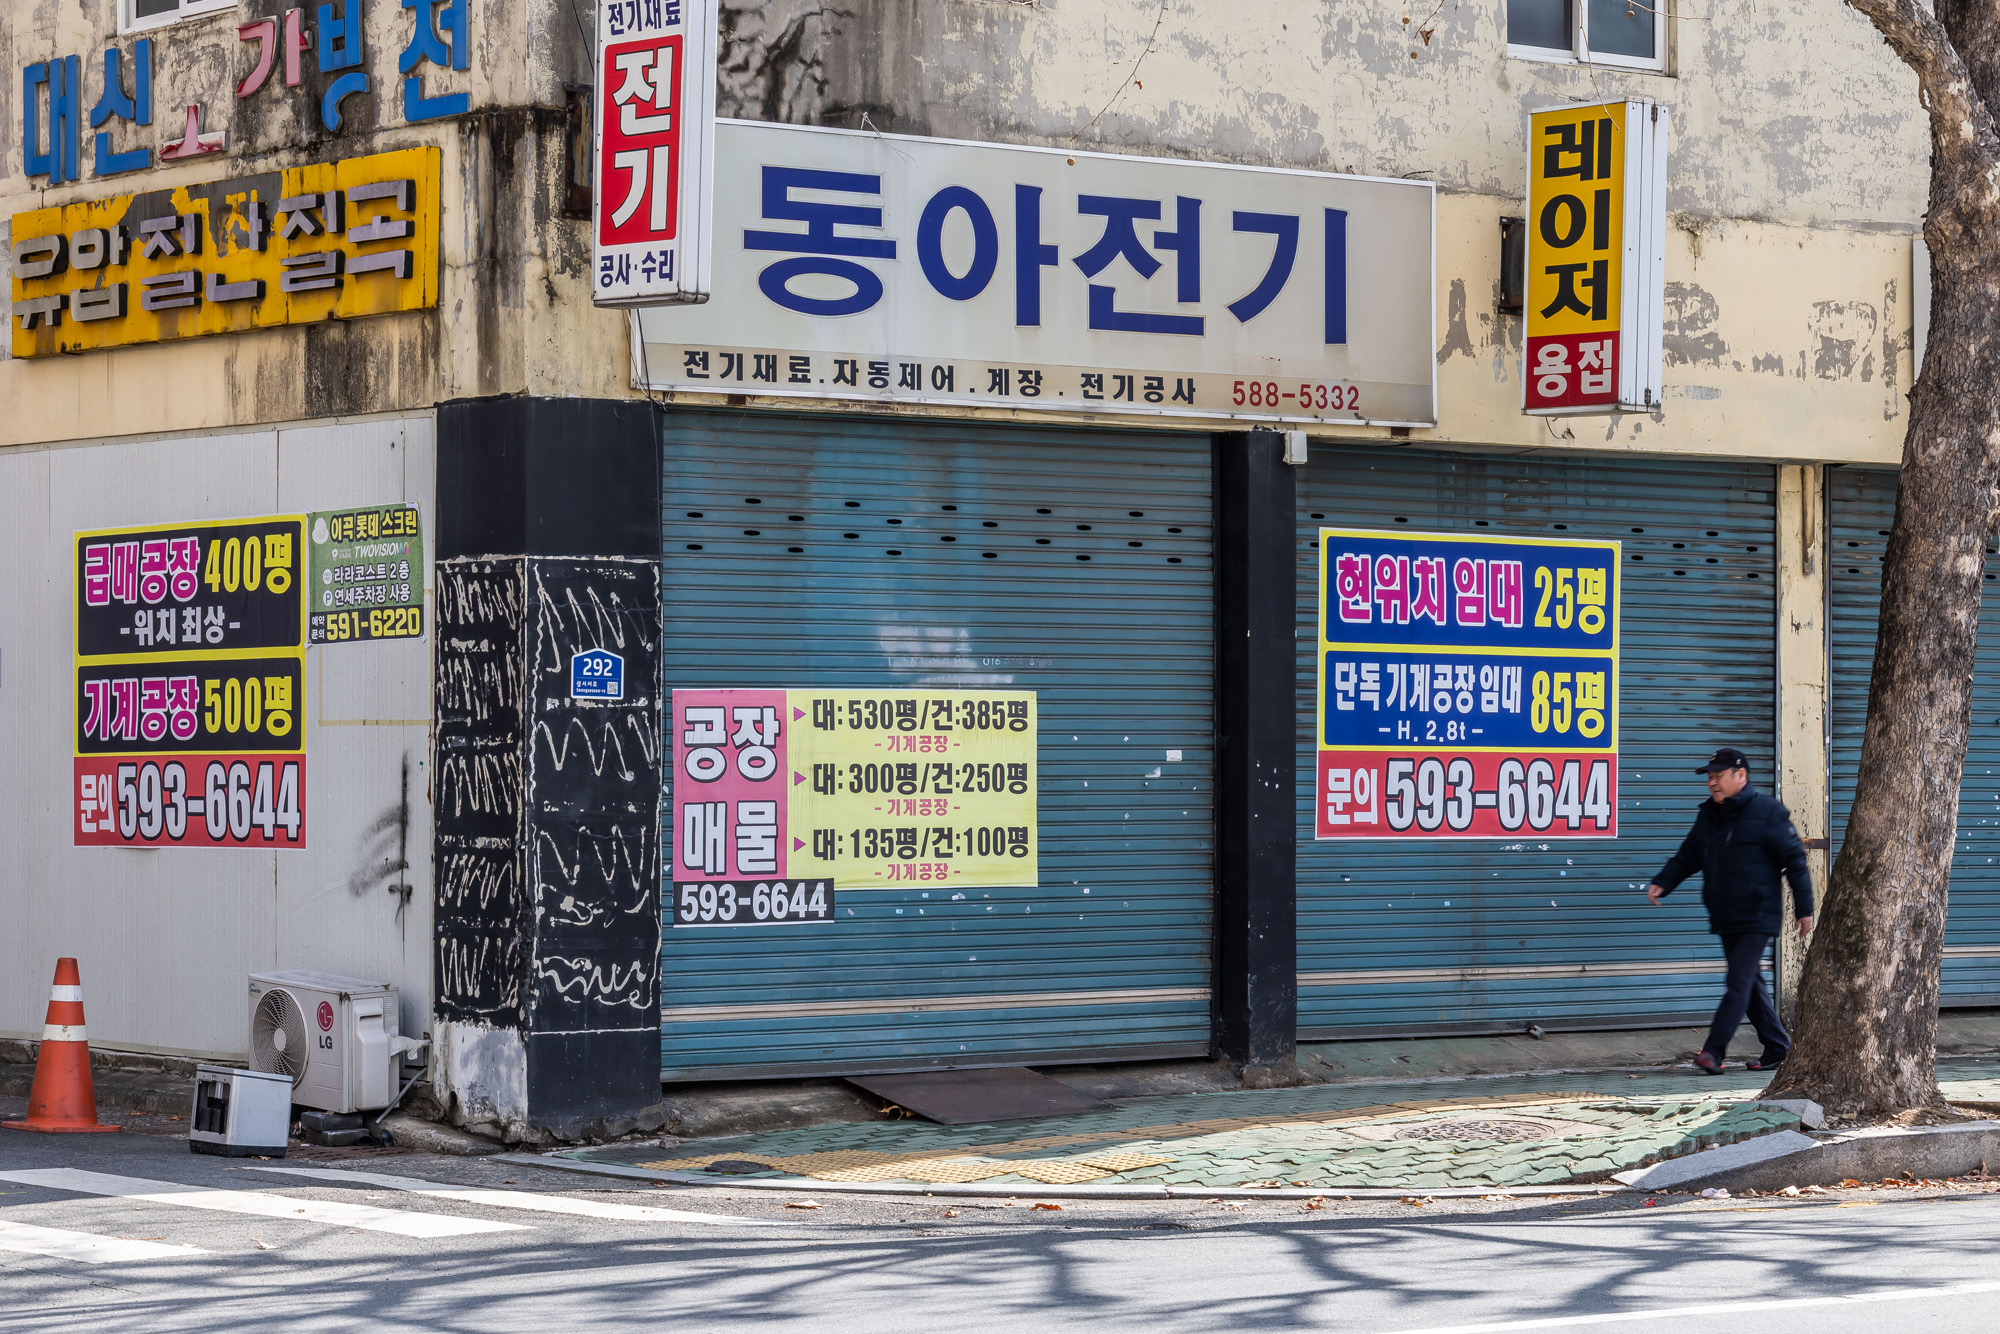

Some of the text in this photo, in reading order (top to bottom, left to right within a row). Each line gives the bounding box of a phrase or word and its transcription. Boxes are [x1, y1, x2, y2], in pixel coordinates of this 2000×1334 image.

[608, 0, 681, 36] 전기재료
[611, 45, 674, 232] 전기
[1539, 118, 1612, 321] 레이저
[743, 164, 1348, 346] 동아전기
[1233, 380, 1360, 411] 588-5332
[1533, 340, 1613, 398] 용접
[331, 514, 354, 542] 이곡
[381, 508, 417, 538] 스크린
[84, 533, 292, 606] 급매공장 400평
[334, 563, 387, 584] 라라코스트
[334, 583, 411, 606] 연세주차장 사용
[1336, 553, 1606, 634] 현위치 임대 25평
[326, 607, 420, 640] 591-6220
[583, 658, 613, 676] 292
[83, 675, 292, 741] 기계공장 500평
[1531, 671, 1605, 738] 85평
[683, 705, 781, 782] 공장
[80, 760, 301, 841] 문의 593-6644
[1327, 757, 1611, 831] 문의 593-6644
[683, 800, 779, 876] 매물
[680, 882, 827, 922] 593-6644
[319, 1035, 333, 1050] LG
